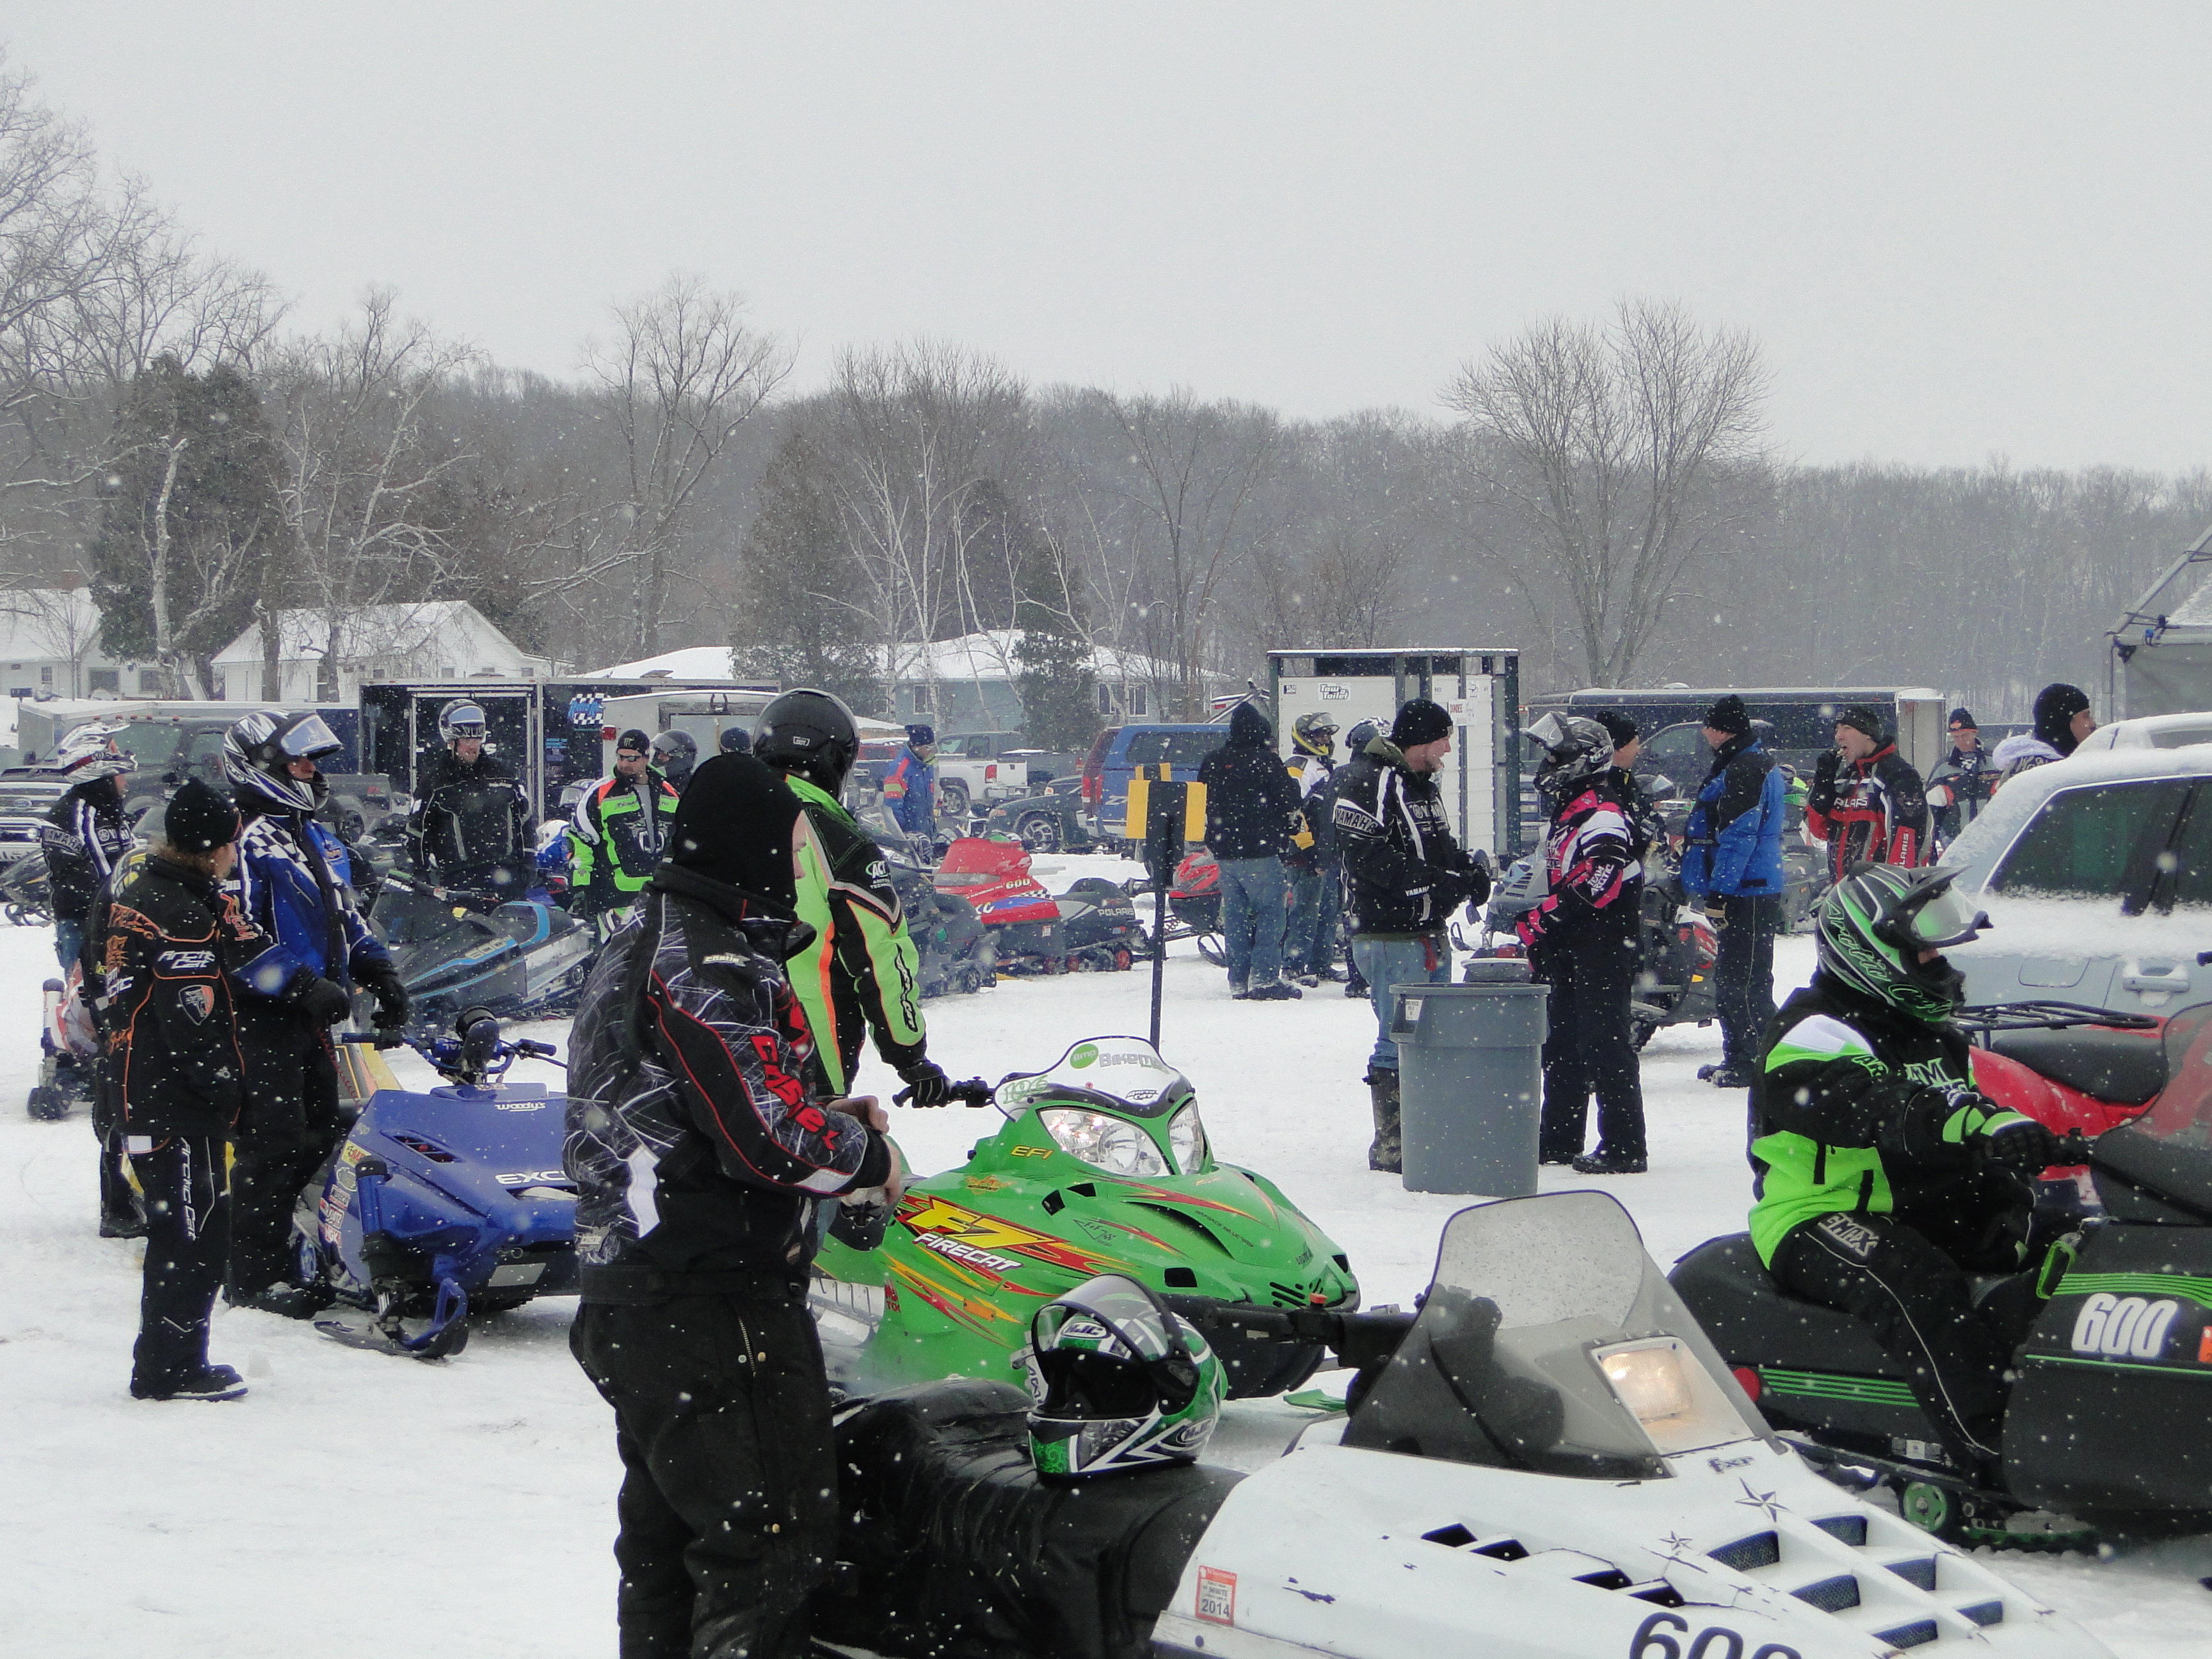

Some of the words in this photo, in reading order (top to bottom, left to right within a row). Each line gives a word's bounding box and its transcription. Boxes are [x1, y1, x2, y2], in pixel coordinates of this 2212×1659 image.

[1336, 808, 1379, 834] YAMAHA
[1006, 879, 1031, 890] 600
[1098, 908, 1135, 917] POLARIS
[495, 1102, 546, 1112] woody's
[1011, 1144, 1054, 1160] EFI
[906, 1198, 1057, 1249] F7
[912, 1232, 1024, 1272] FIRECAT
[2071, 1292, 2179, 1358] 600
[1201, 1599, 1230, 1617] 2014
